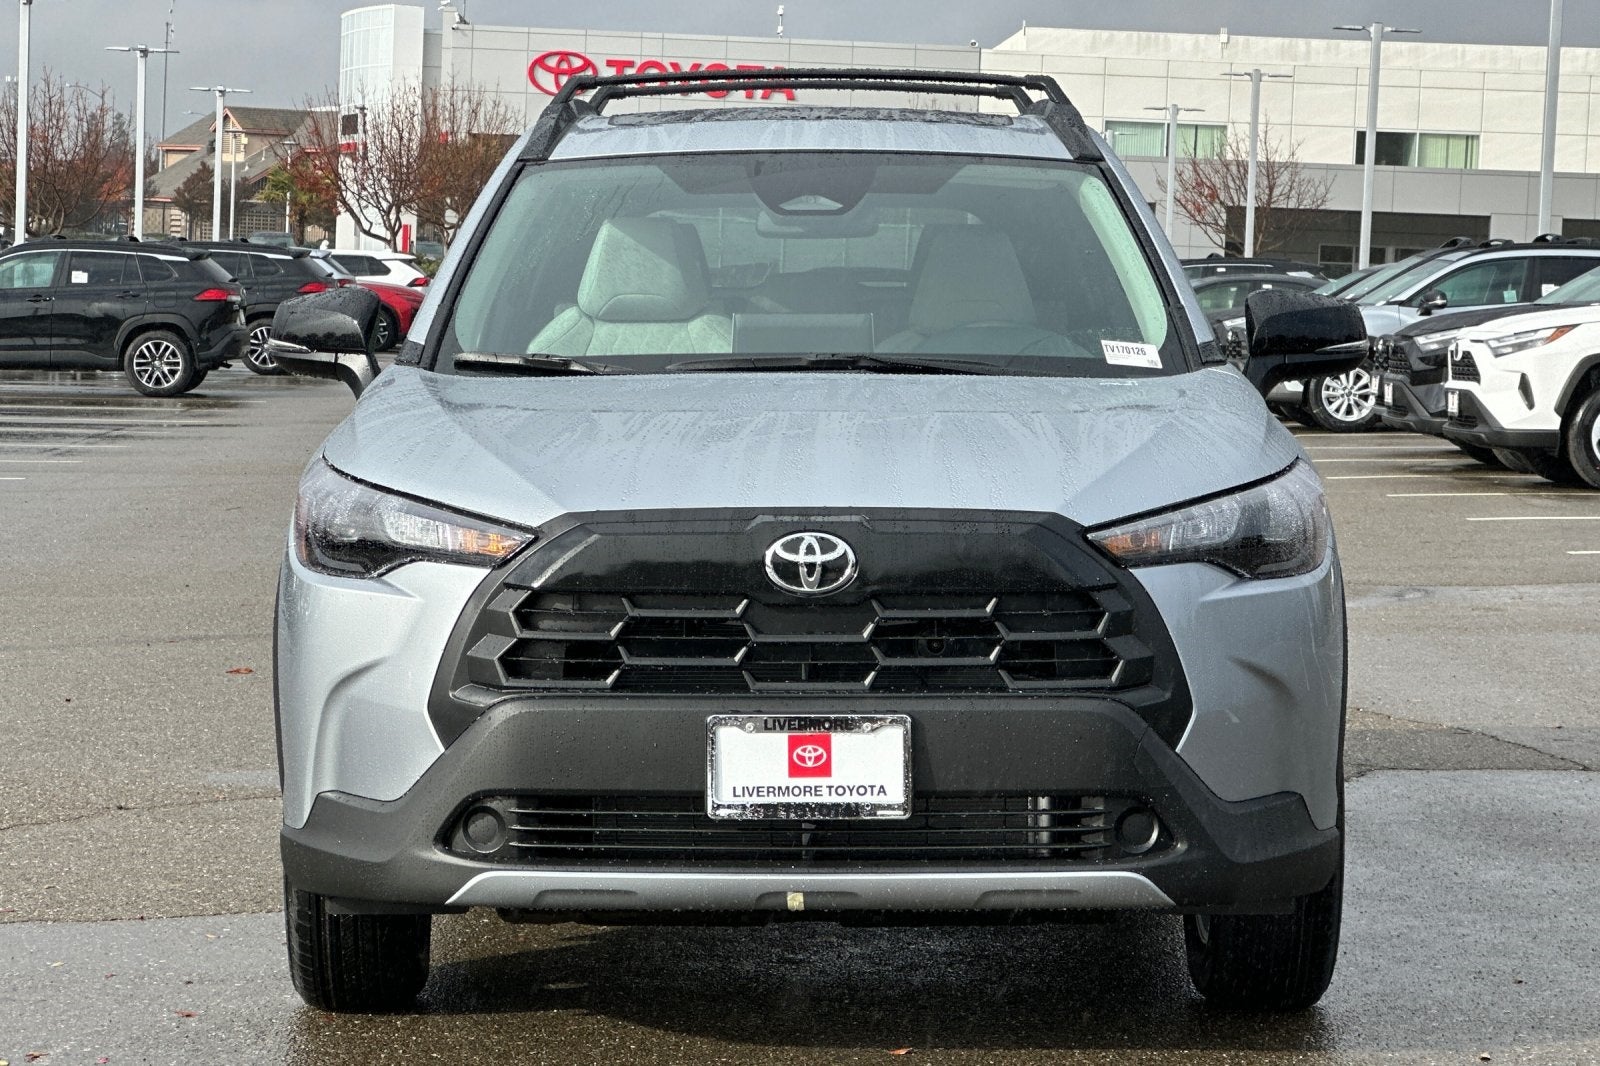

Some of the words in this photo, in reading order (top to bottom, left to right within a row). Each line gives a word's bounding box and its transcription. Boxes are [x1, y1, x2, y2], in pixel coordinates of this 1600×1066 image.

[1104, 344, 1147, 356] TV170126
[763, 718, 854, 732] LIVERMORE
[732, 785, 823, 798] LIVERMORE
[826, 784, 887, 797] TOYOTA
